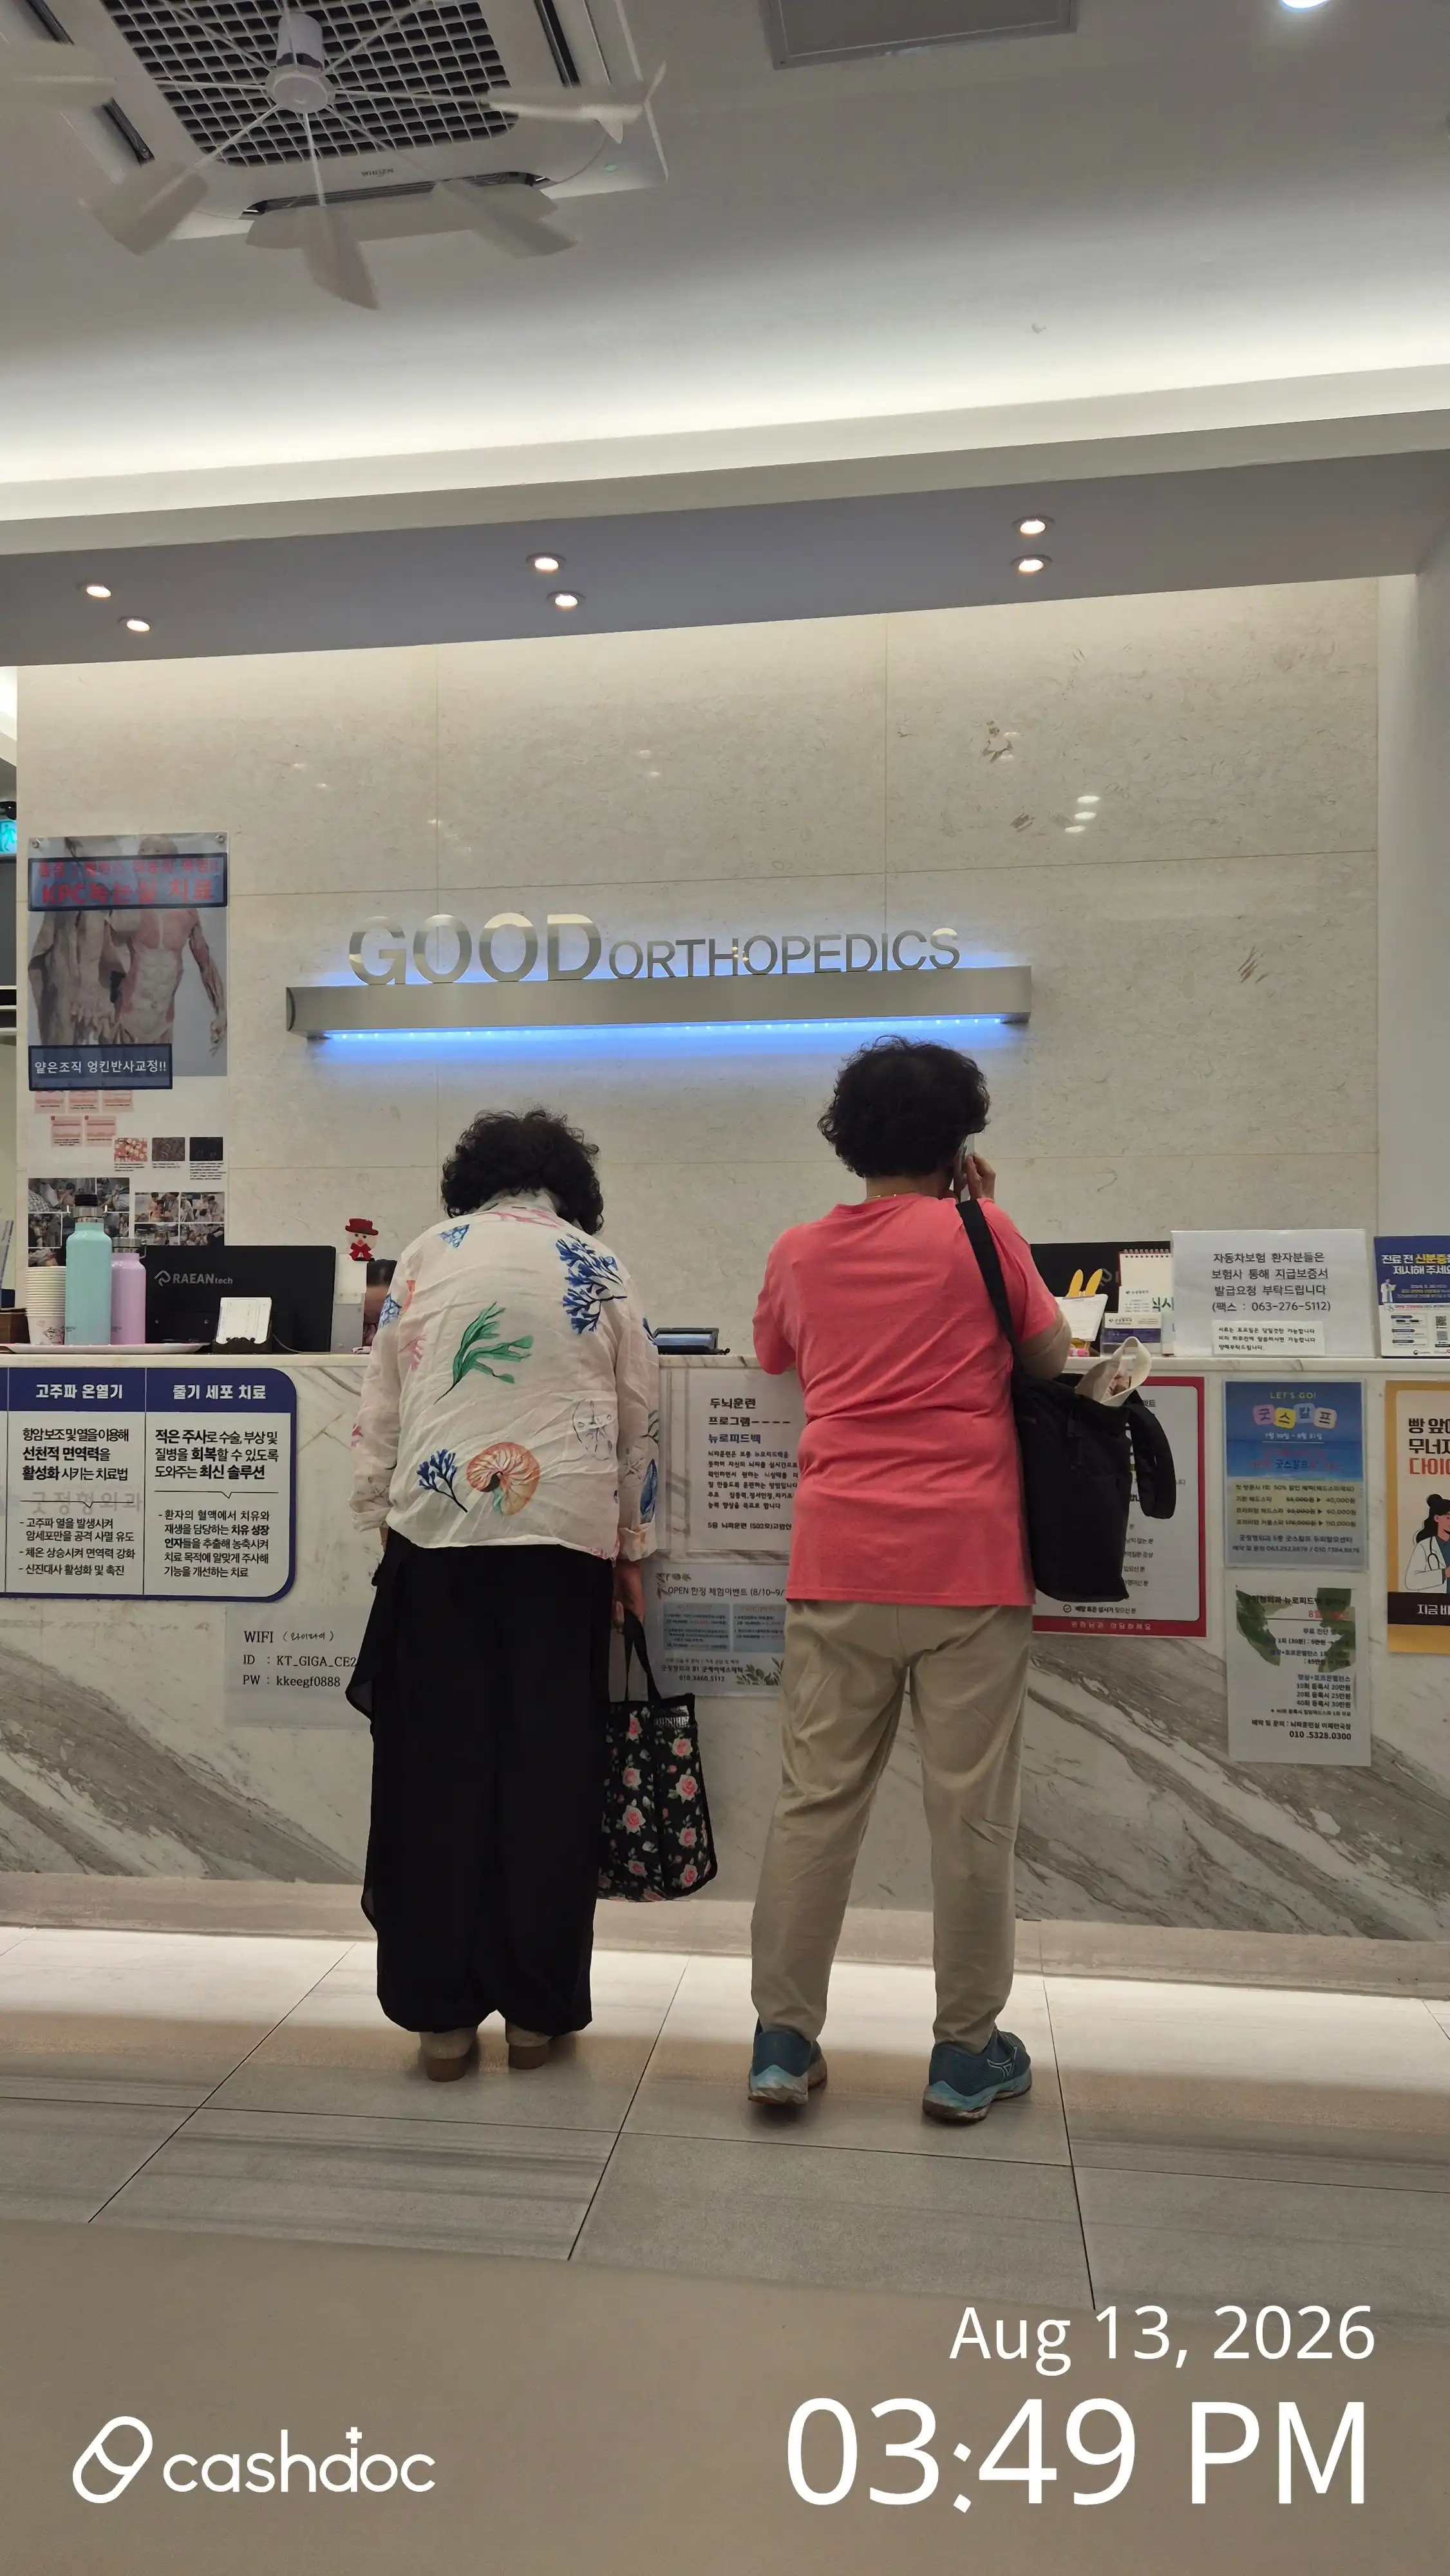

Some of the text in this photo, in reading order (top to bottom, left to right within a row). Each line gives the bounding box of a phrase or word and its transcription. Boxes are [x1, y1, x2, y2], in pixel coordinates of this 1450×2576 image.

[169, 877, 214, 903] 치료
[348, 912, 961, 985] GOOD ORTHOPEDICS
[88, 1060, 166, 1073] 엉킨반사교정!!
[1214, 1253, 1324, 1264] 자동차보험 환자분들은
[1382, 1255, 1402, 1264] 진료
[1404, 1255, 1413, 1264] 전
[1212, 1268, 1328, 1280] 보험사 통해 지급보증서
[1393, 1265, 1424, 1274] 제시해
[173, 1273, 232, 1284] RAEANtech
[1214, 1285, 1326, 1296] 발급요청 부탁드립니다
[1212, 1302, 1331, 1312] (팩스 063-276-5112)
[36, 1384, 123, 1399] 고주파 온열기
[173, 1385, 267, 1400] 줄기 세포 치료
[710, 1398, 756, 1409] 두뇌훈련
[1409, 1418, 1425, 1434] 빵
[155, 1429, 180, 1444] 적은
[182, 1429, 218, 1444] 주사로
[709, 1434, 761, 1444] 뉴로피드백
[23, 1446, 111, 1461] 선천적 면역력을
[155, 1447, 279, 1463] 질병을 회복할 수 있도록
[155, 1464, 265, 1480] 도와주는 최신 솔루션
[1409, 1457, 1450, 1475] 다이
[22, 1466, 128, 1481] 활성화 시키는 치료법
[164, 1510, 270, 1521] 환자의 혈액에서 치유와
[26, 1518, 113, 1529] 고주파 열을 발생시켜
[164, 1524, 270, 1536] 재생을 담당하는 치유 성장
[26, 1531, 135, 1542] 암세포만을 공격 사멸 유도
[164, 1538, 268, 1549] 인자들을 추출해 농축시켜
[25, 1548, 135, 1559] 체온 상승시켜 면역력 강화
[164, 1552, 269, 1564] 치료 목적에 알맞게 주사해
[25, 1564, 124, 1576] 신진대사 활성화 및 촉진
[164, 1566, 249, 1578] 기능을 개선하는 치료
[668, 1587, 748, 1597] OPEN 한정 체험이벤트
[1417, 1604, 1438, 1615] 지금
[243, 1631, 274, 1643] WIFI
[243, 1654, 255, 1665] ID
[243, 1675, 341, 1688] PW kkeegf0888
